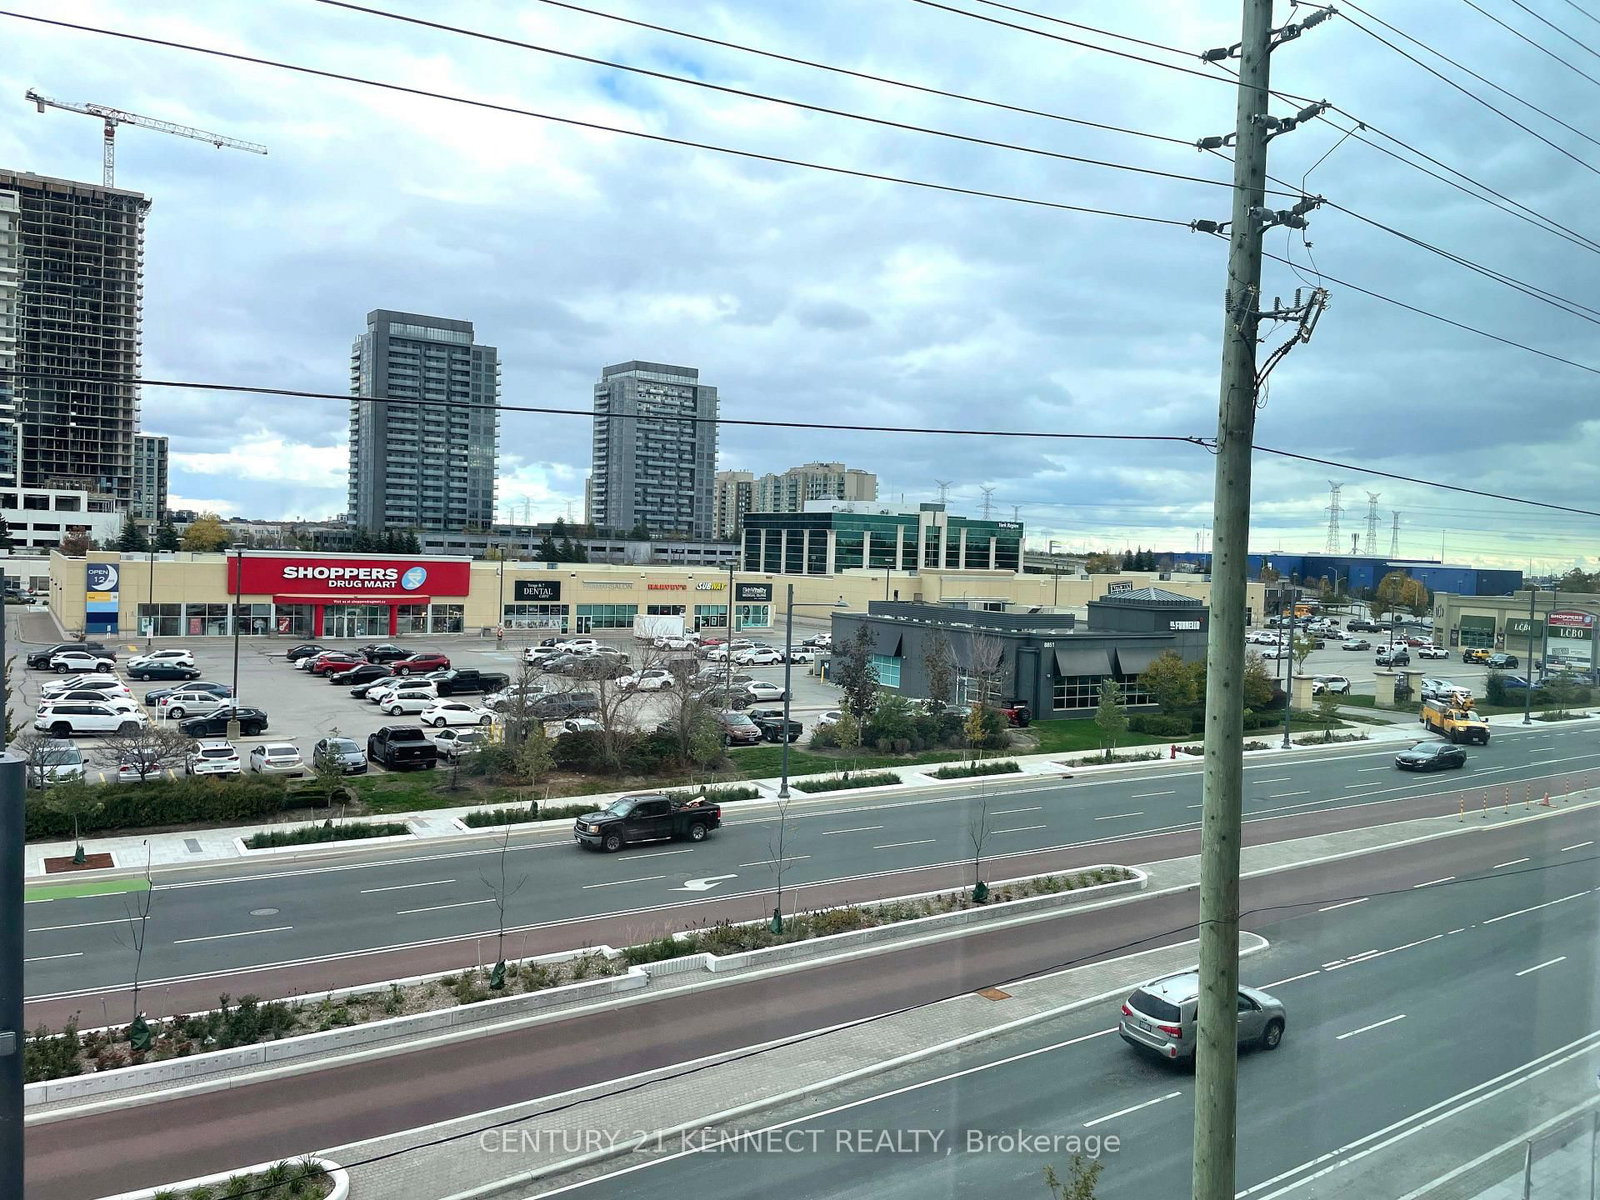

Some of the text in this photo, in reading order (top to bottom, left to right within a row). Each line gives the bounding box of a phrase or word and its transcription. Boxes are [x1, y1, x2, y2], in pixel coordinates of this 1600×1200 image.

[282, 566, 398, 580] SHOPPERS
[328, 580, 398, 588] DRUG MART
[1560, 628, 1583, 638] LCBO
